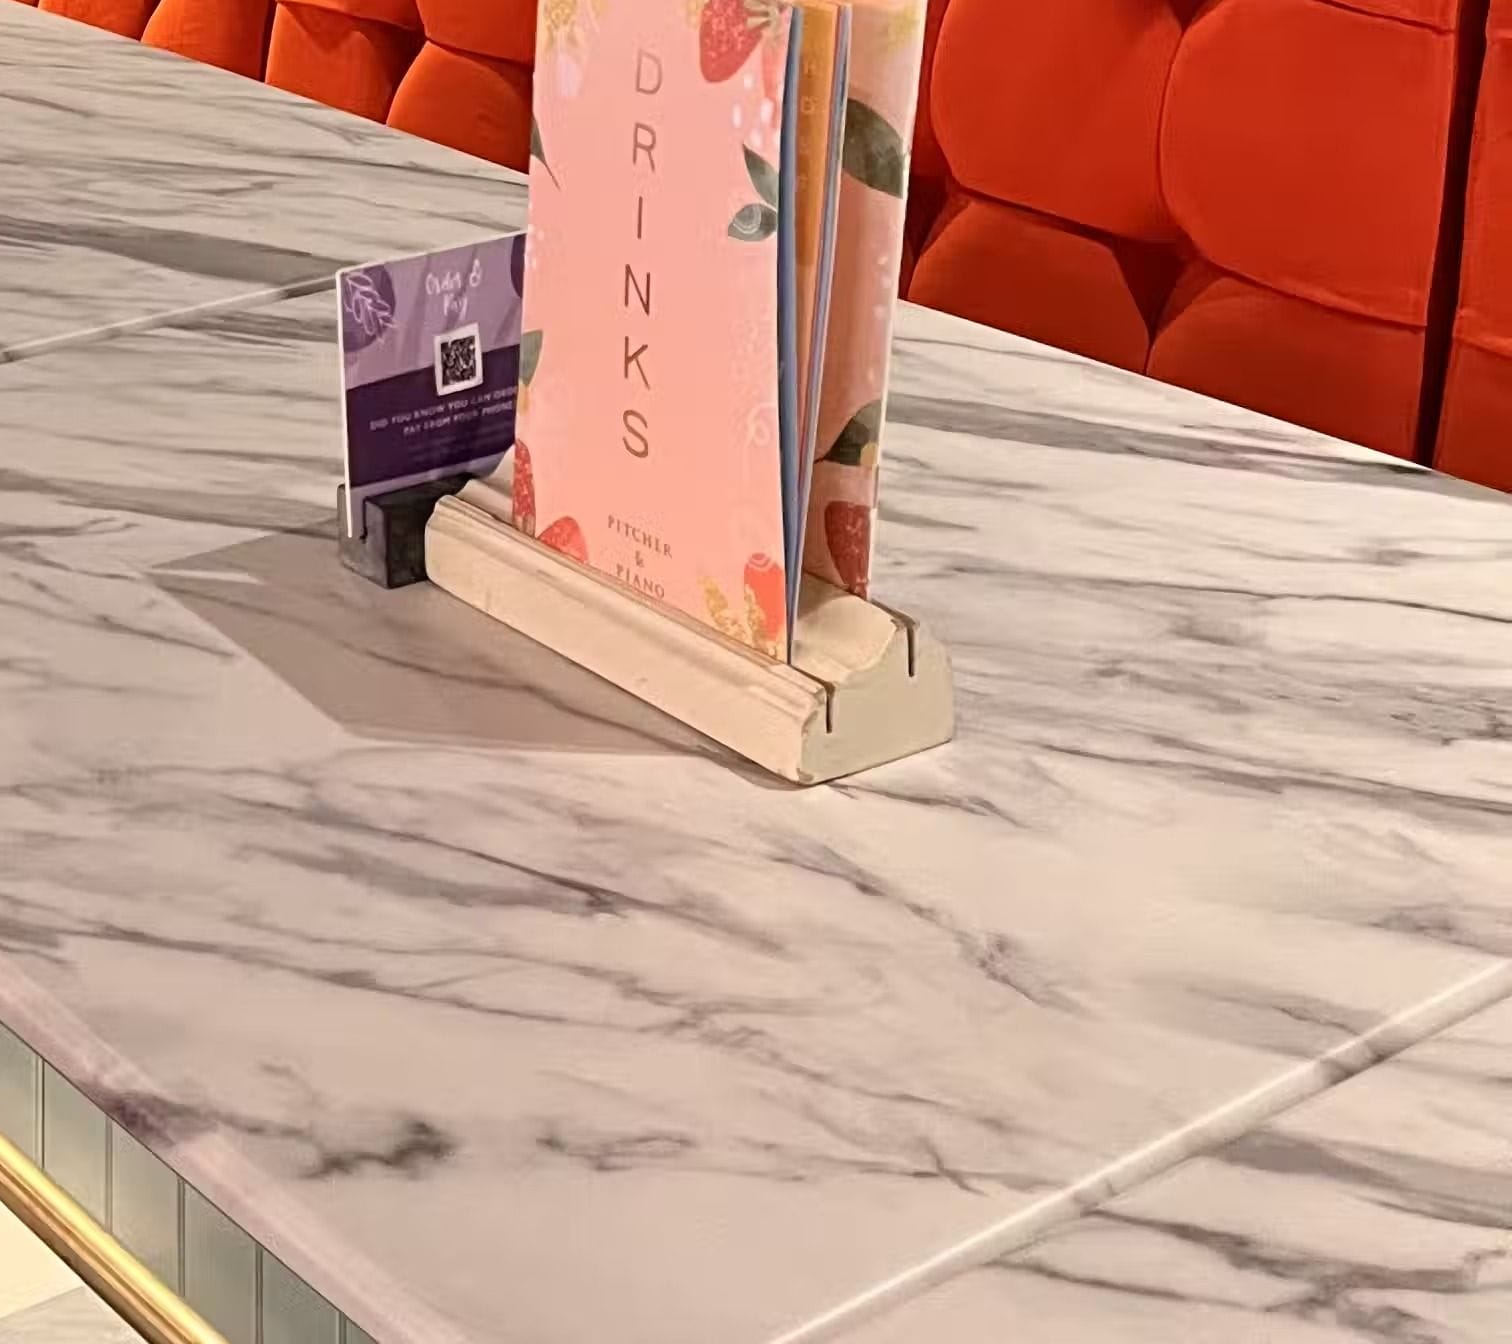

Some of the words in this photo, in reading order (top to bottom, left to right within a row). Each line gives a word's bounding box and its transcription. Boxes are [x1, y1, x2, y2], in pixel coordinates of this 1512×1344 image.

[621, 48, 664, 460] DRINKS
[608, 515, 673, 560] PITCHER
[616, 563, 665, 600] PIANO
